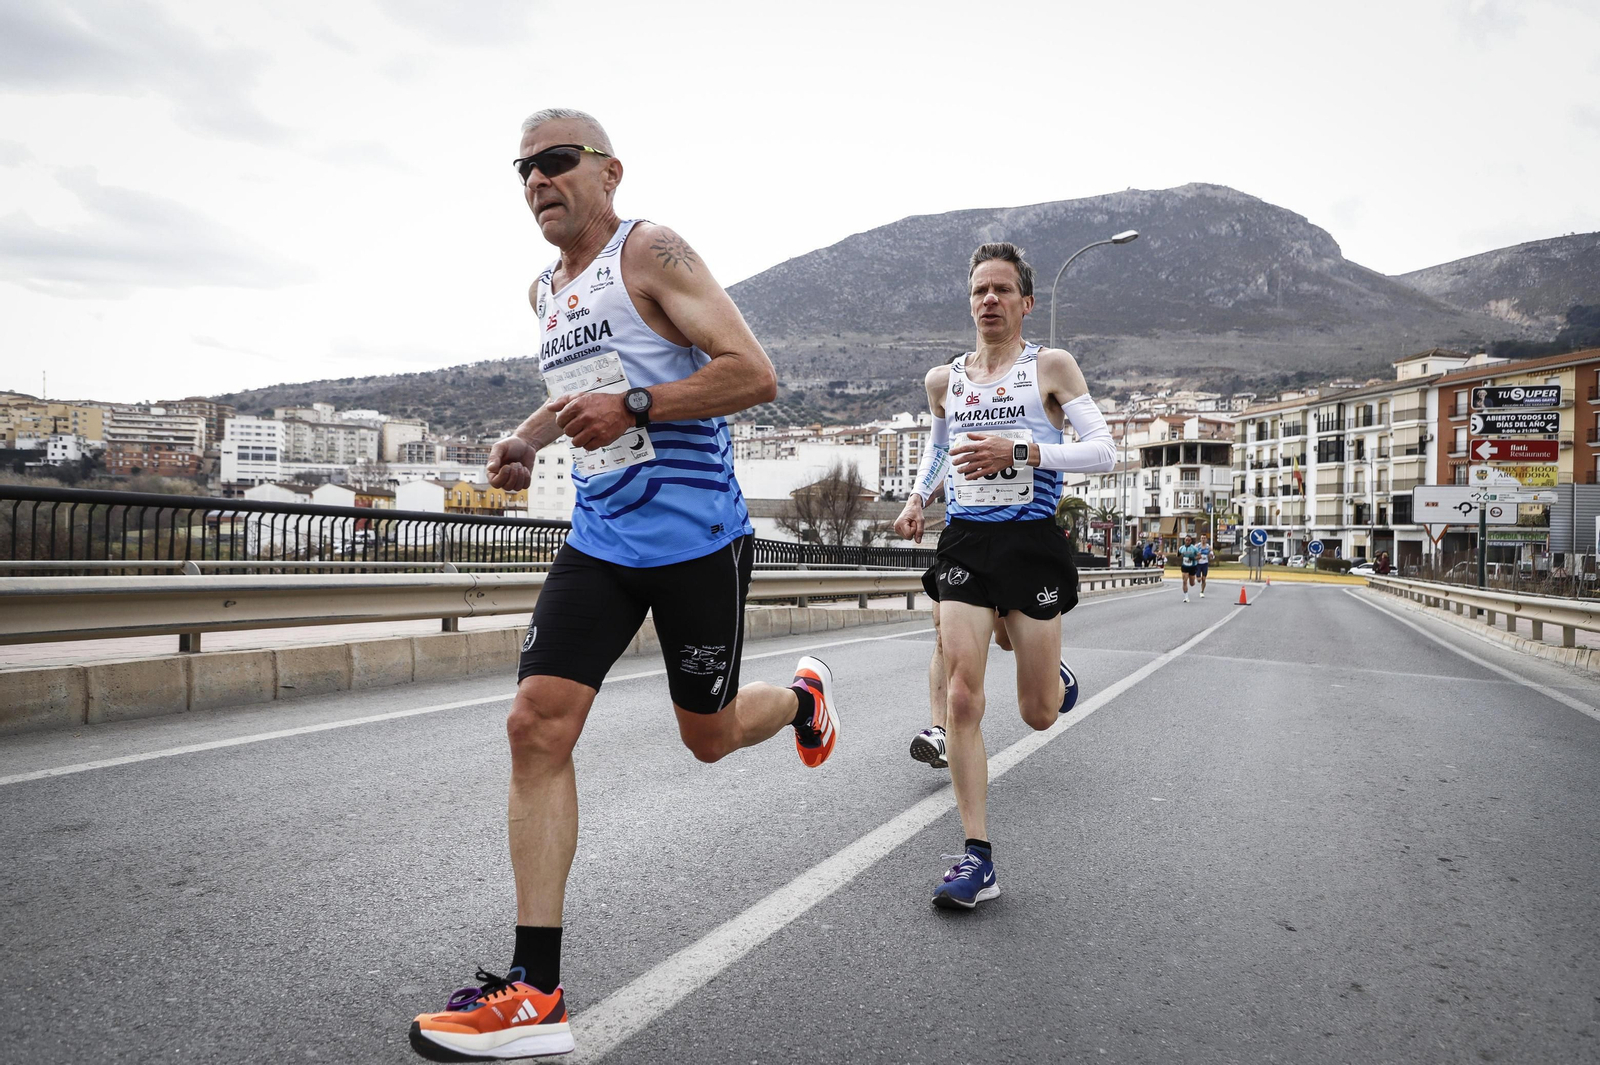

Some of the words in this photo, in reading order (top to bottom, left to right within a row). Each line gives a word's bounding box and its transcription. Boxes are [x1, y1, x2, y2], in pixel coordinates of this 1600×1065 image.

[564, 345, 602, 363] ATLETISMO
[1510, 388, 1558, 400] SUPER
[955, 405, 1026, 422] MARACENA
